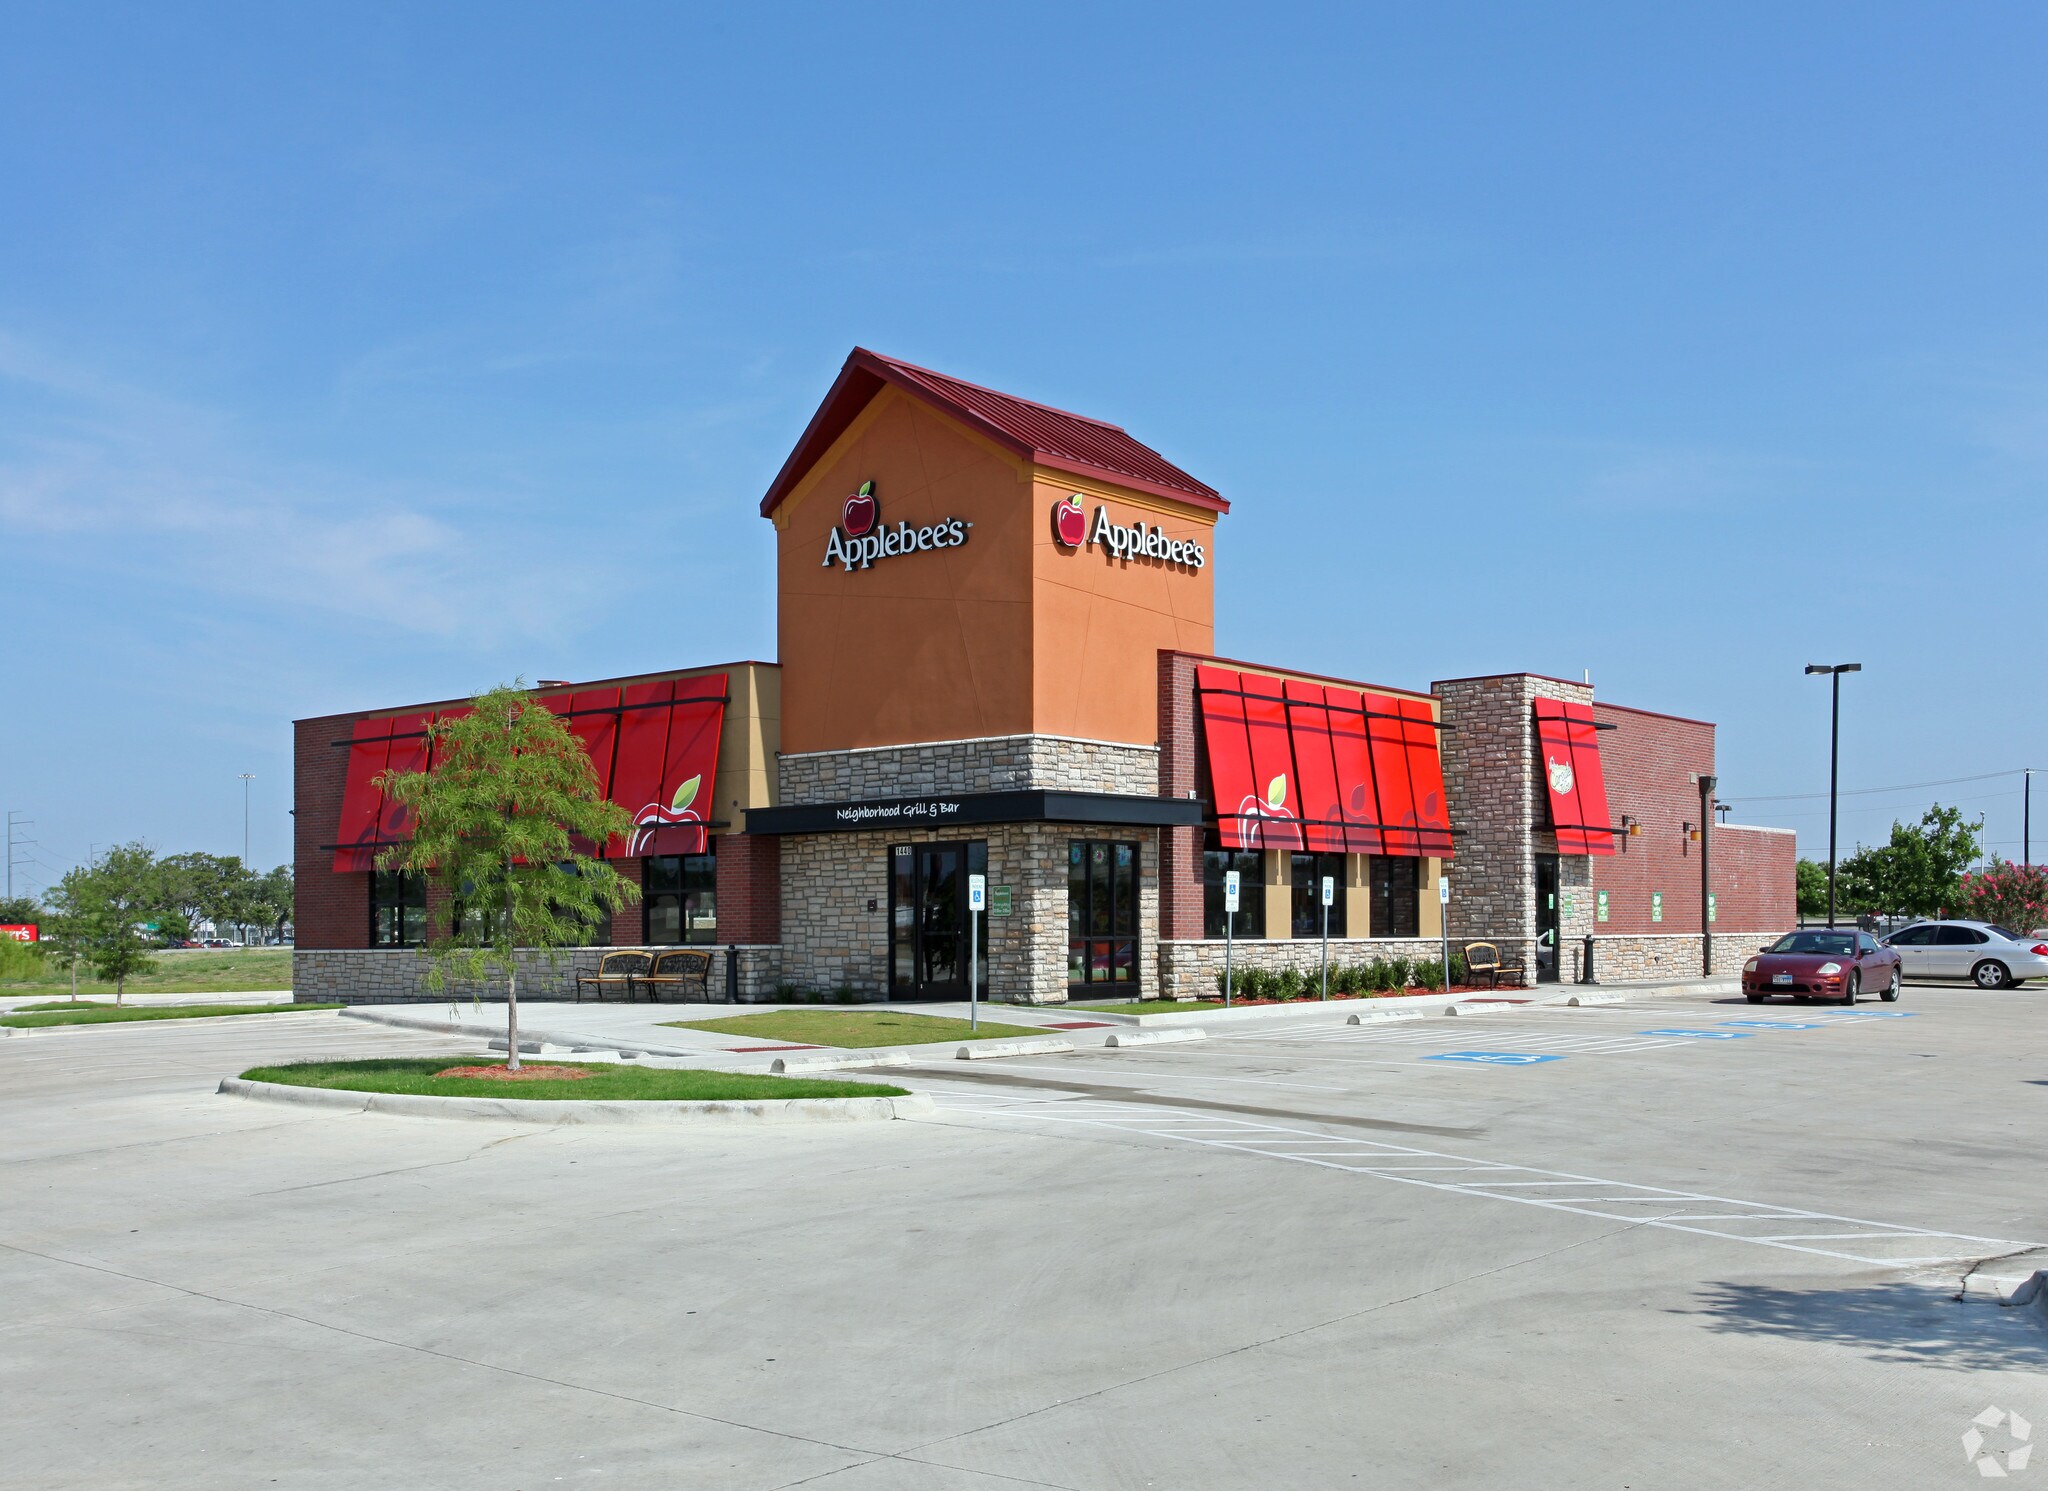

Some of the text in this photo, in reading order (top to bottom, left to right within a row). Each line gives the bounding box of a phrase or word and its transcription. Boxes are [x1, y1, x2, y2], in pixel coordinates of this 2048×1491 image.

[822, 517, 965, 571] Applebee's
[1092, 505, 1205, 568] Applebee's
[837, 802, 960, 822] Neighborhood Grill & Bar
